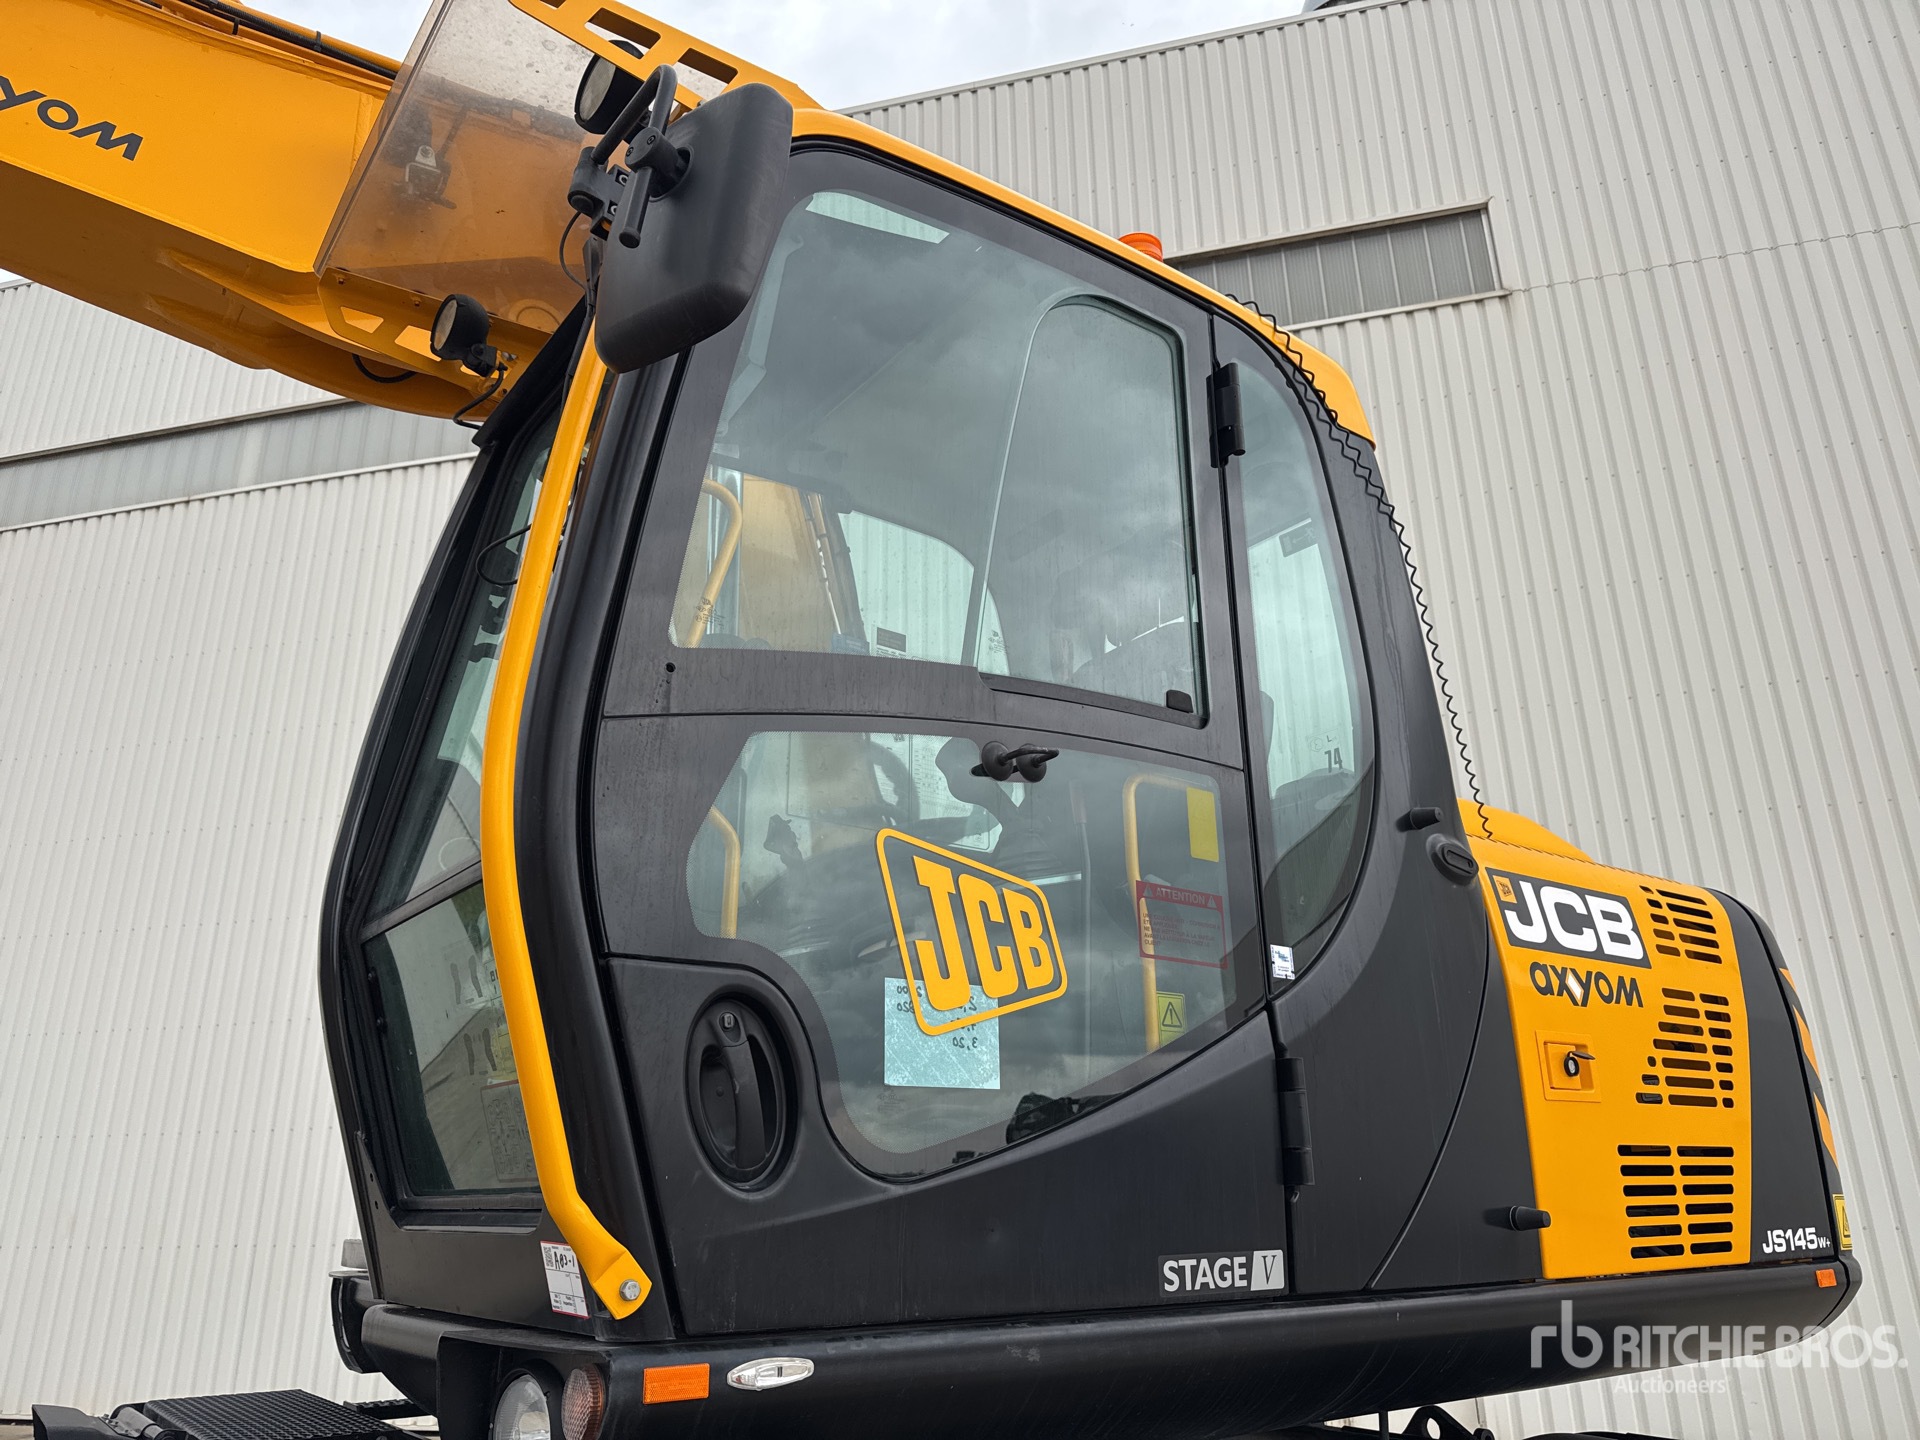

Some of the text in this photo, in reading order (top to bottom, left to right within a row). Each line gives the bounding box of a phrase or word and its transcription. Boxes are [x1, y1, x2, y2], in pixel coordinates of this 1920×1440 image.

[1156, 887, 1206, 904] ATTENTION
[1504, 880, 1644, 960] JCB
[912, 855, 1054, 1011] JCB
[1163, 1254, 1278, 1292] STAGE V
